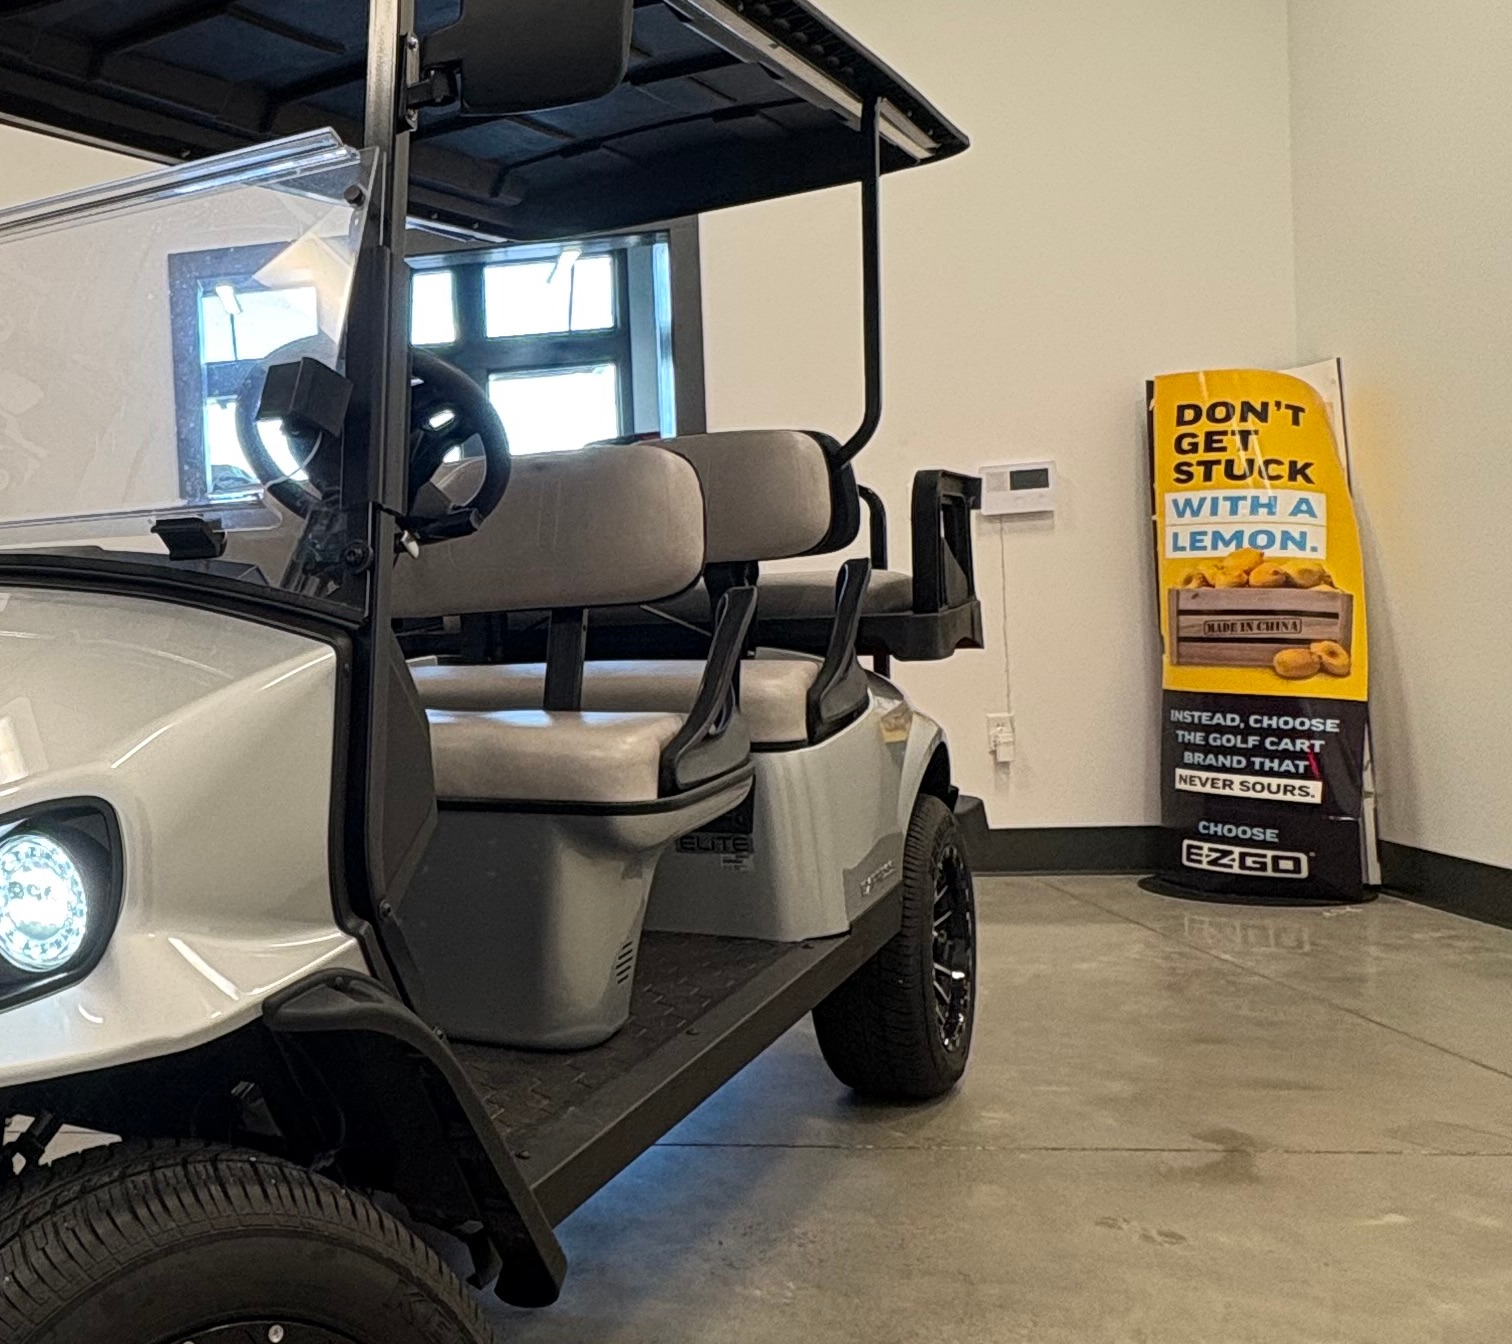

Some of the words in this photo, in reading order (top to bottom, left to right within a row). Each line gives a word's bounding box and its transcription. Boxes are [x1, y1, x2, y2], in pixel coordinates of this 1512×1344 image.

[1176, 401, 1305, 427] DON'T
[1174, 430, 1259, 455] GET
[1173, 459, 1315, 485] STUCK
[1172, 496, 1278, 518] WITH
[1288, 498, 1318, 519] A
[1172, 530, 1318, 552] LEMON.
[1206, 622, 1237, 633] MADE
[1240, 621, 1254, 632] IN
[1256, 621, 1298, 632] CHINA
[1170, 709, 1245, 729] INSTEAD,
[1249, 715, 1340, 732] CHOOSE
[1176, 730, 1206, 744] THE
[1208, 734, 1260, 748] GOLF
[1265, 737, 1325, 753] CART
[1183, 751, 1247, 769] BRAND
[1250, 757, 1309, 774] THAT
[1178, 773, 1234, 791] NEVER
[1239, 781, 1315, 798] SOURS.
[1198, 821, 1279, 843] CHOOSE
[1185, 843, 1302, 875] EZGO
